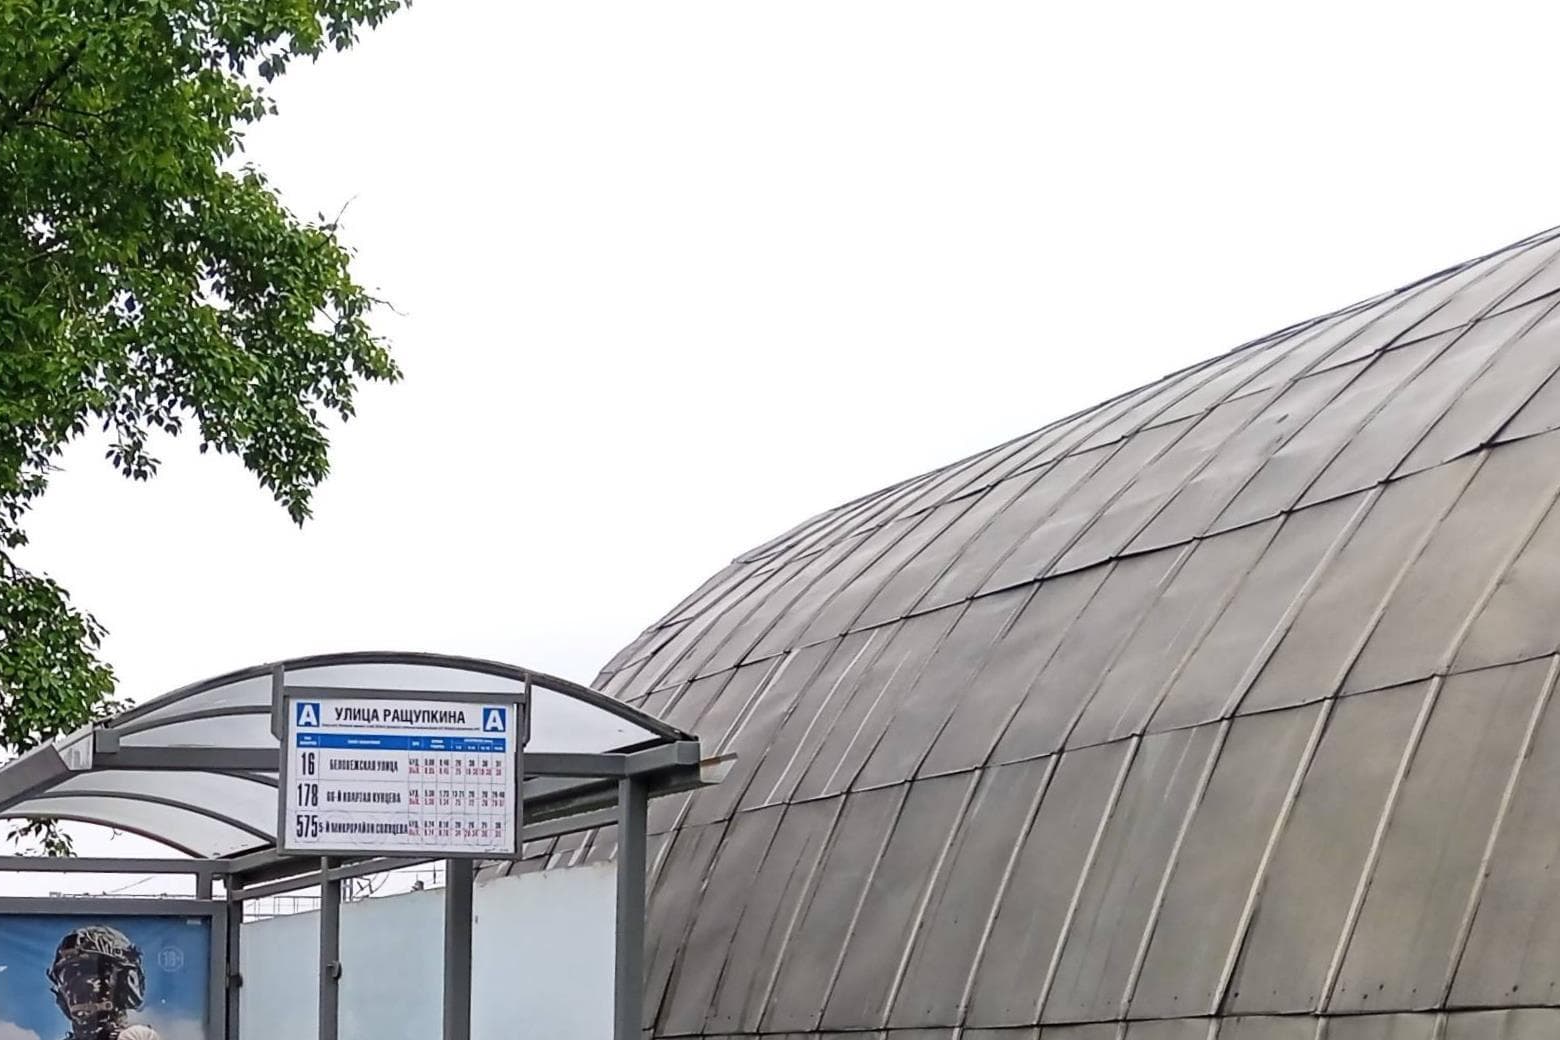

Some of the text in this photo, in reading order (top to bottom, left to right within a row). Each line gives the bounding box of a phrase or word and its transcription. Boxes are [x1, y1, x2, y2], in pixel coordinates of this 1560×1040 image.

[334, 707, 466, 725] УЛИЦА РАЩУПКИНА
[301, 752, 316, 776] 16
[297, 783, 319, 807] 178
[296, 814, 318, 838] 575
